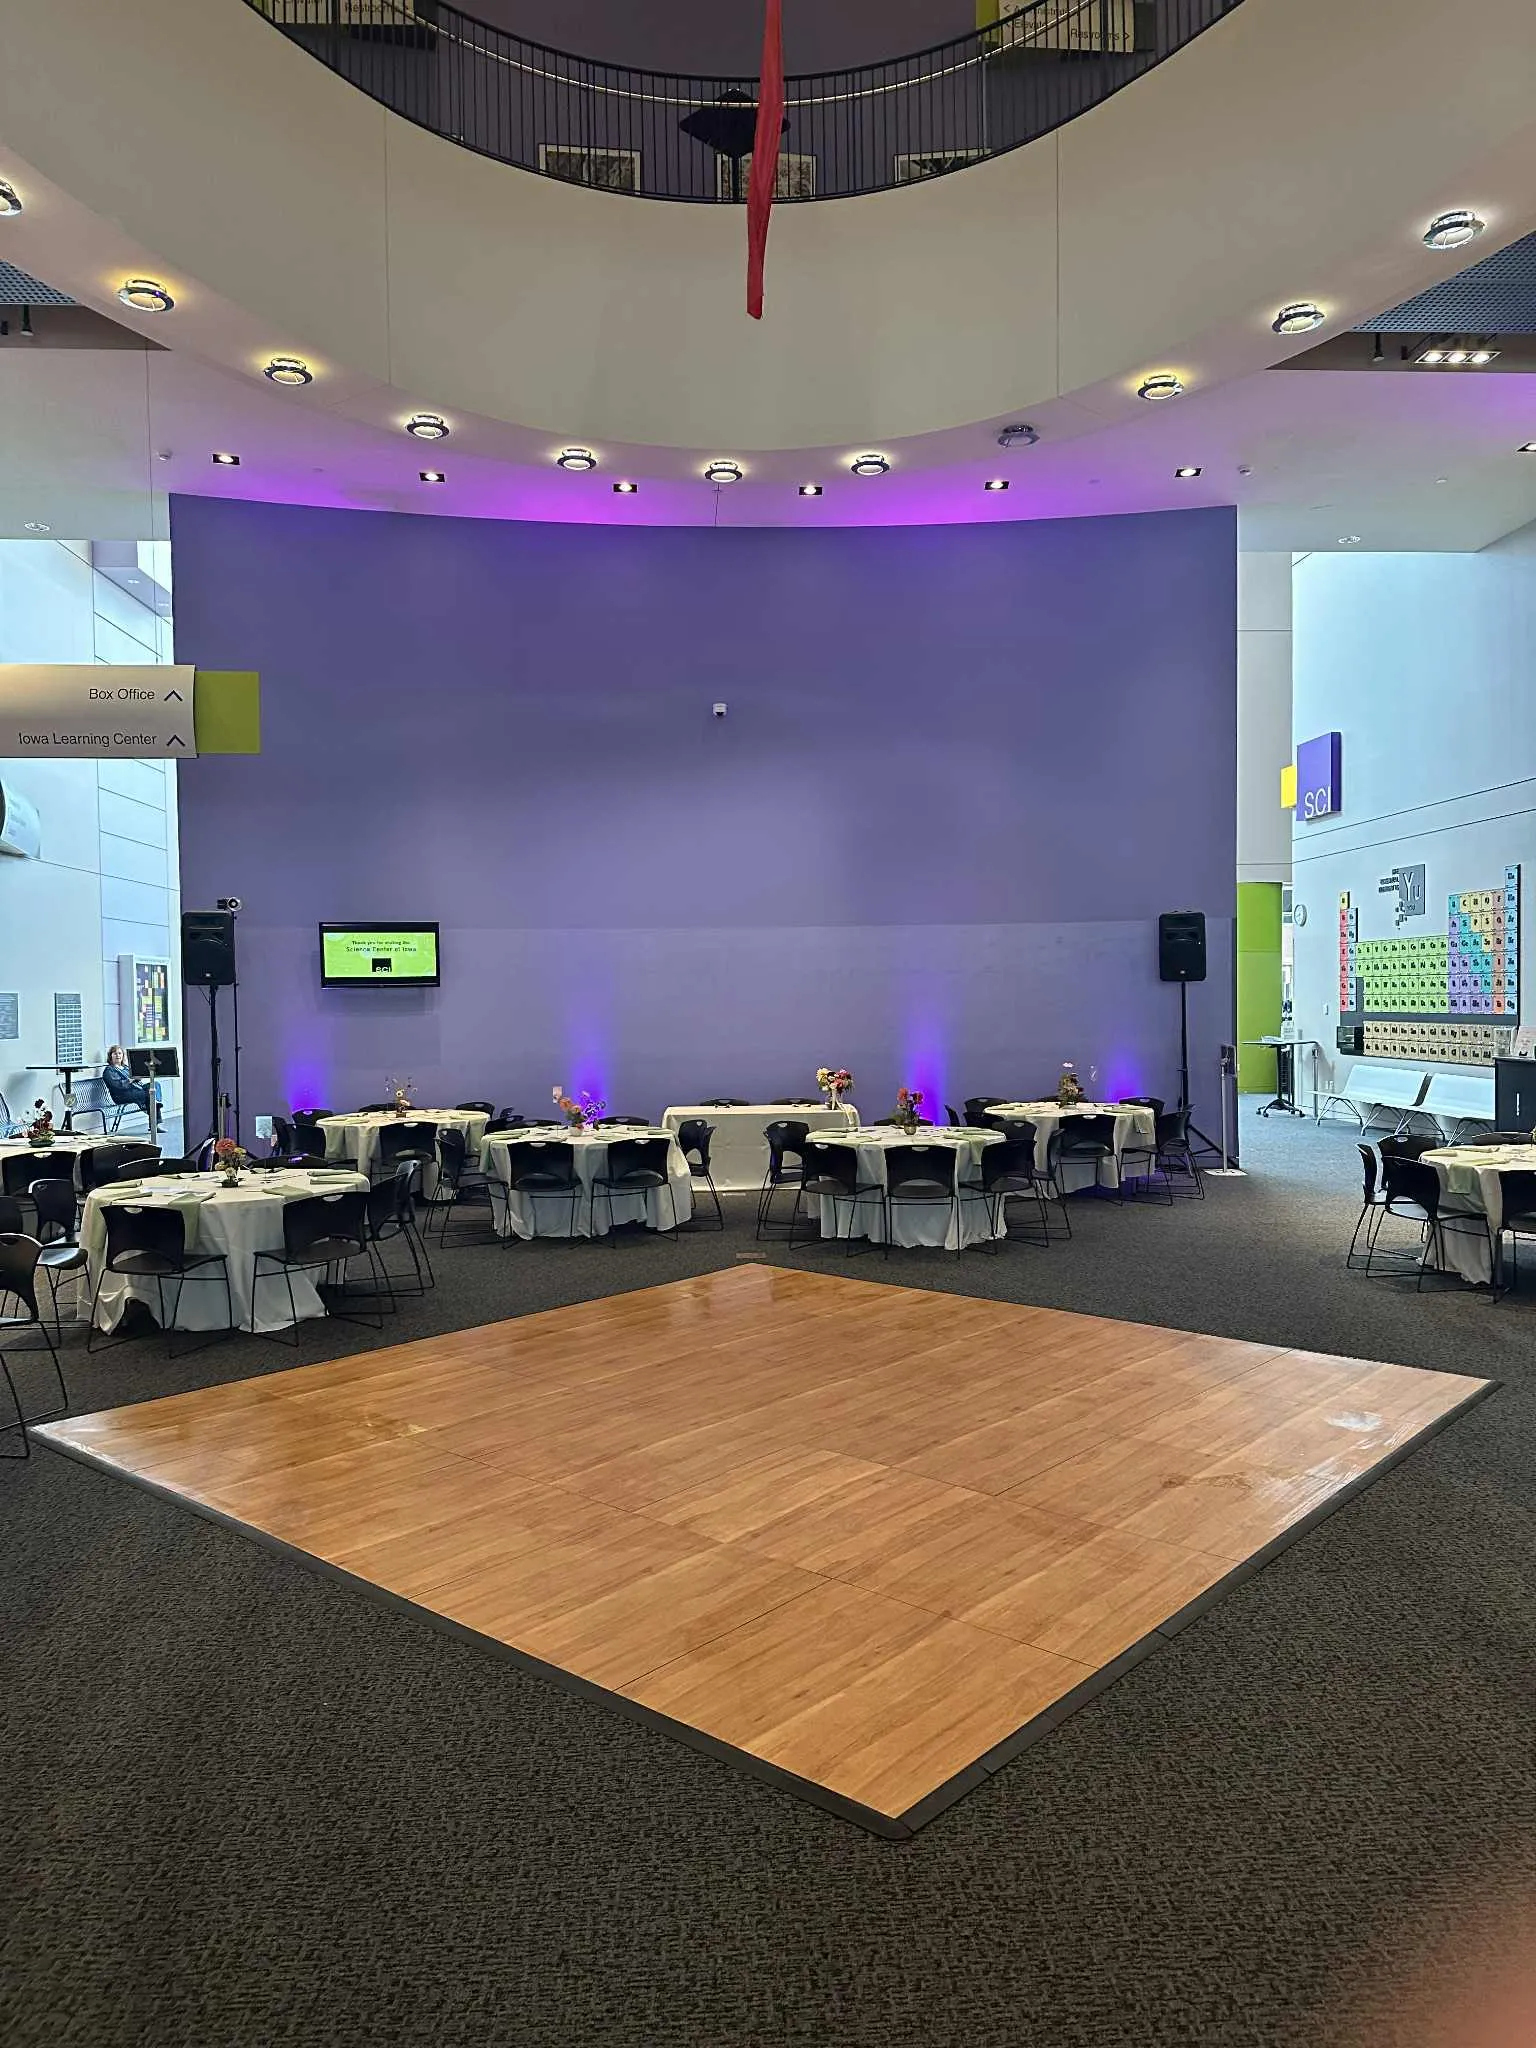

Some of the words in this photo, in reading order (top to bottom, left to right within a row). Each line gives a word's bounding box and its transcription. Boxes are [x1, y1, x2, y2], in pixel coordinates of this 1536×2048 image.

[1071, 28, 1120, 41] Resroms
[89, 688, 114, 700] Box
[117, 688, 155, 700] Office
[18, 733, 49, 745] Iowa
[53, 733, 110, 747] Learning
[113, 733, 157, 745] Center
[1304, 786, 1331, 819] SCI
